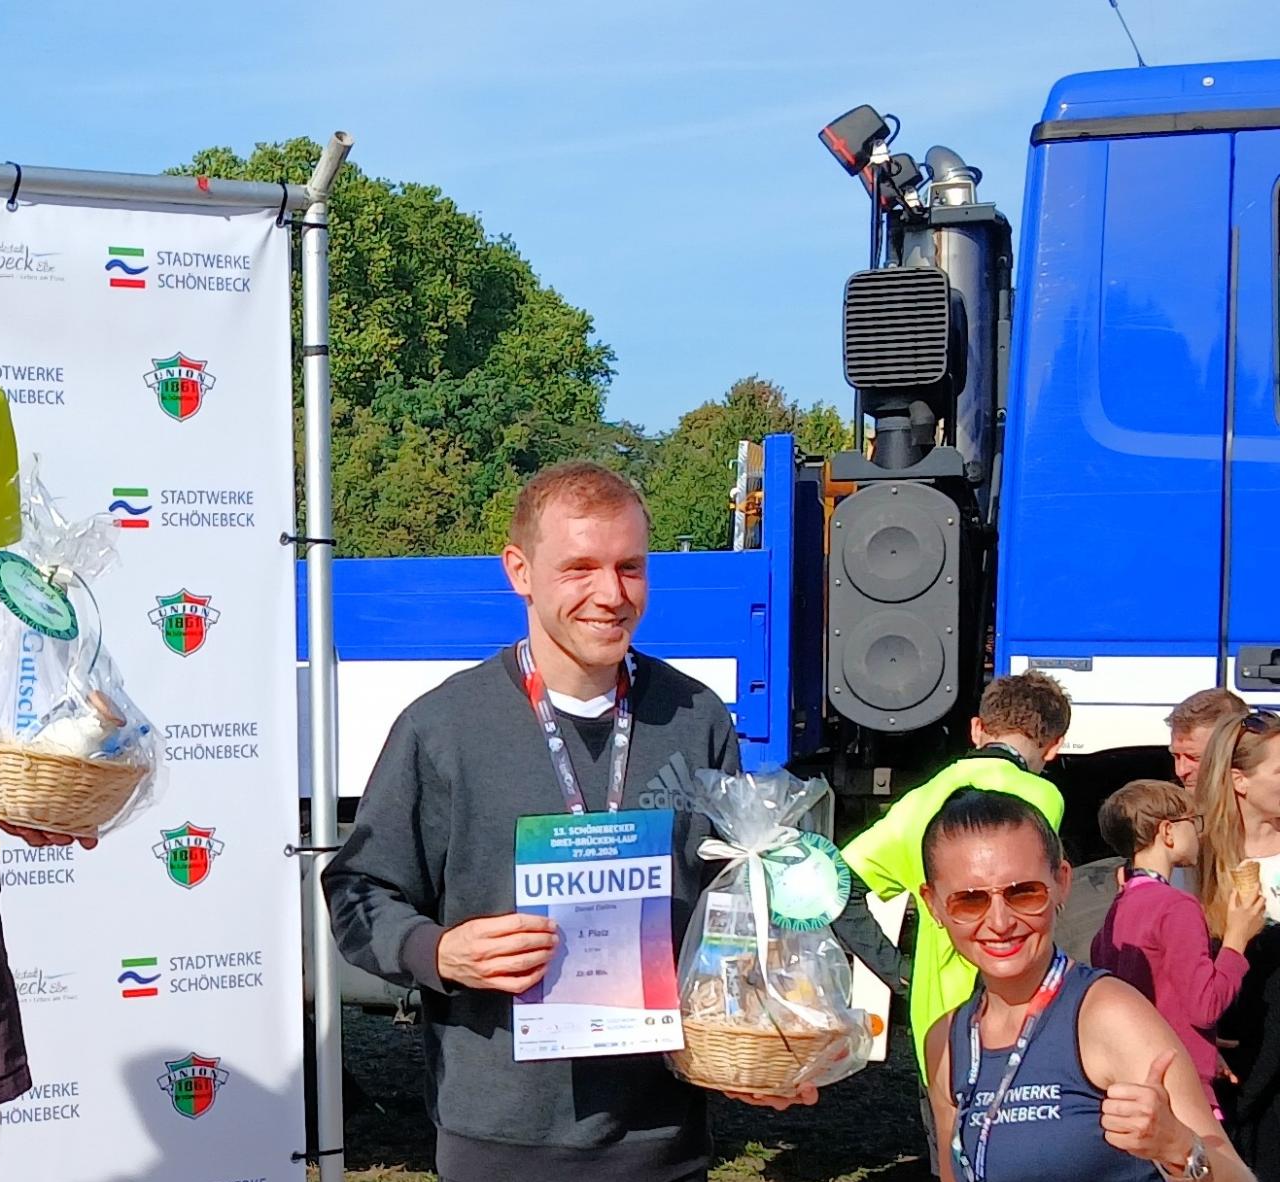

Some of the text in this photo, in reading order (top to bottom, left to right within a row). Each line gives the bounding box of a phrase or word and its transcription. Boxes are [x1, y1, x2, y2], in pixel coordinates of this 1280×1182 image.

[157, 251, 251, 271] STADTWERKE
[157, 272, 251, 293] SCHÖNEBECK
[154, 367, 206, 381] UNION
[163, 380, 198, 392] 1861
[4, 387, 65, 405] NEBECK
[160, 490, 253, 505] STADTWERKE
[161, 508, 254, 528] SCHÖNEBECK
[158, 605, 211, 619] UNION
[167, 616, 201, 629] 1861
[17, 630, 46, 729] Gutsch
[164, 722, 258, 740] STADTWERKE
[164, 741, 259, 760] SCHÖNEBECK
[162, 836, 215, 850] UNION
[2, 846, 74, 864] DTWERKE
[524, 866, 662, 897] URKUNDE
[169, 951, 262, 971] STADTWERKE
[169, 970, 263, 993] SCHÖNEBECK
[168, 1066, 219, 1081] UNION
[974, 1084, 1062, 1107] STATWERKE
[0, 1102, 80, 1125] HÖNEBECK
